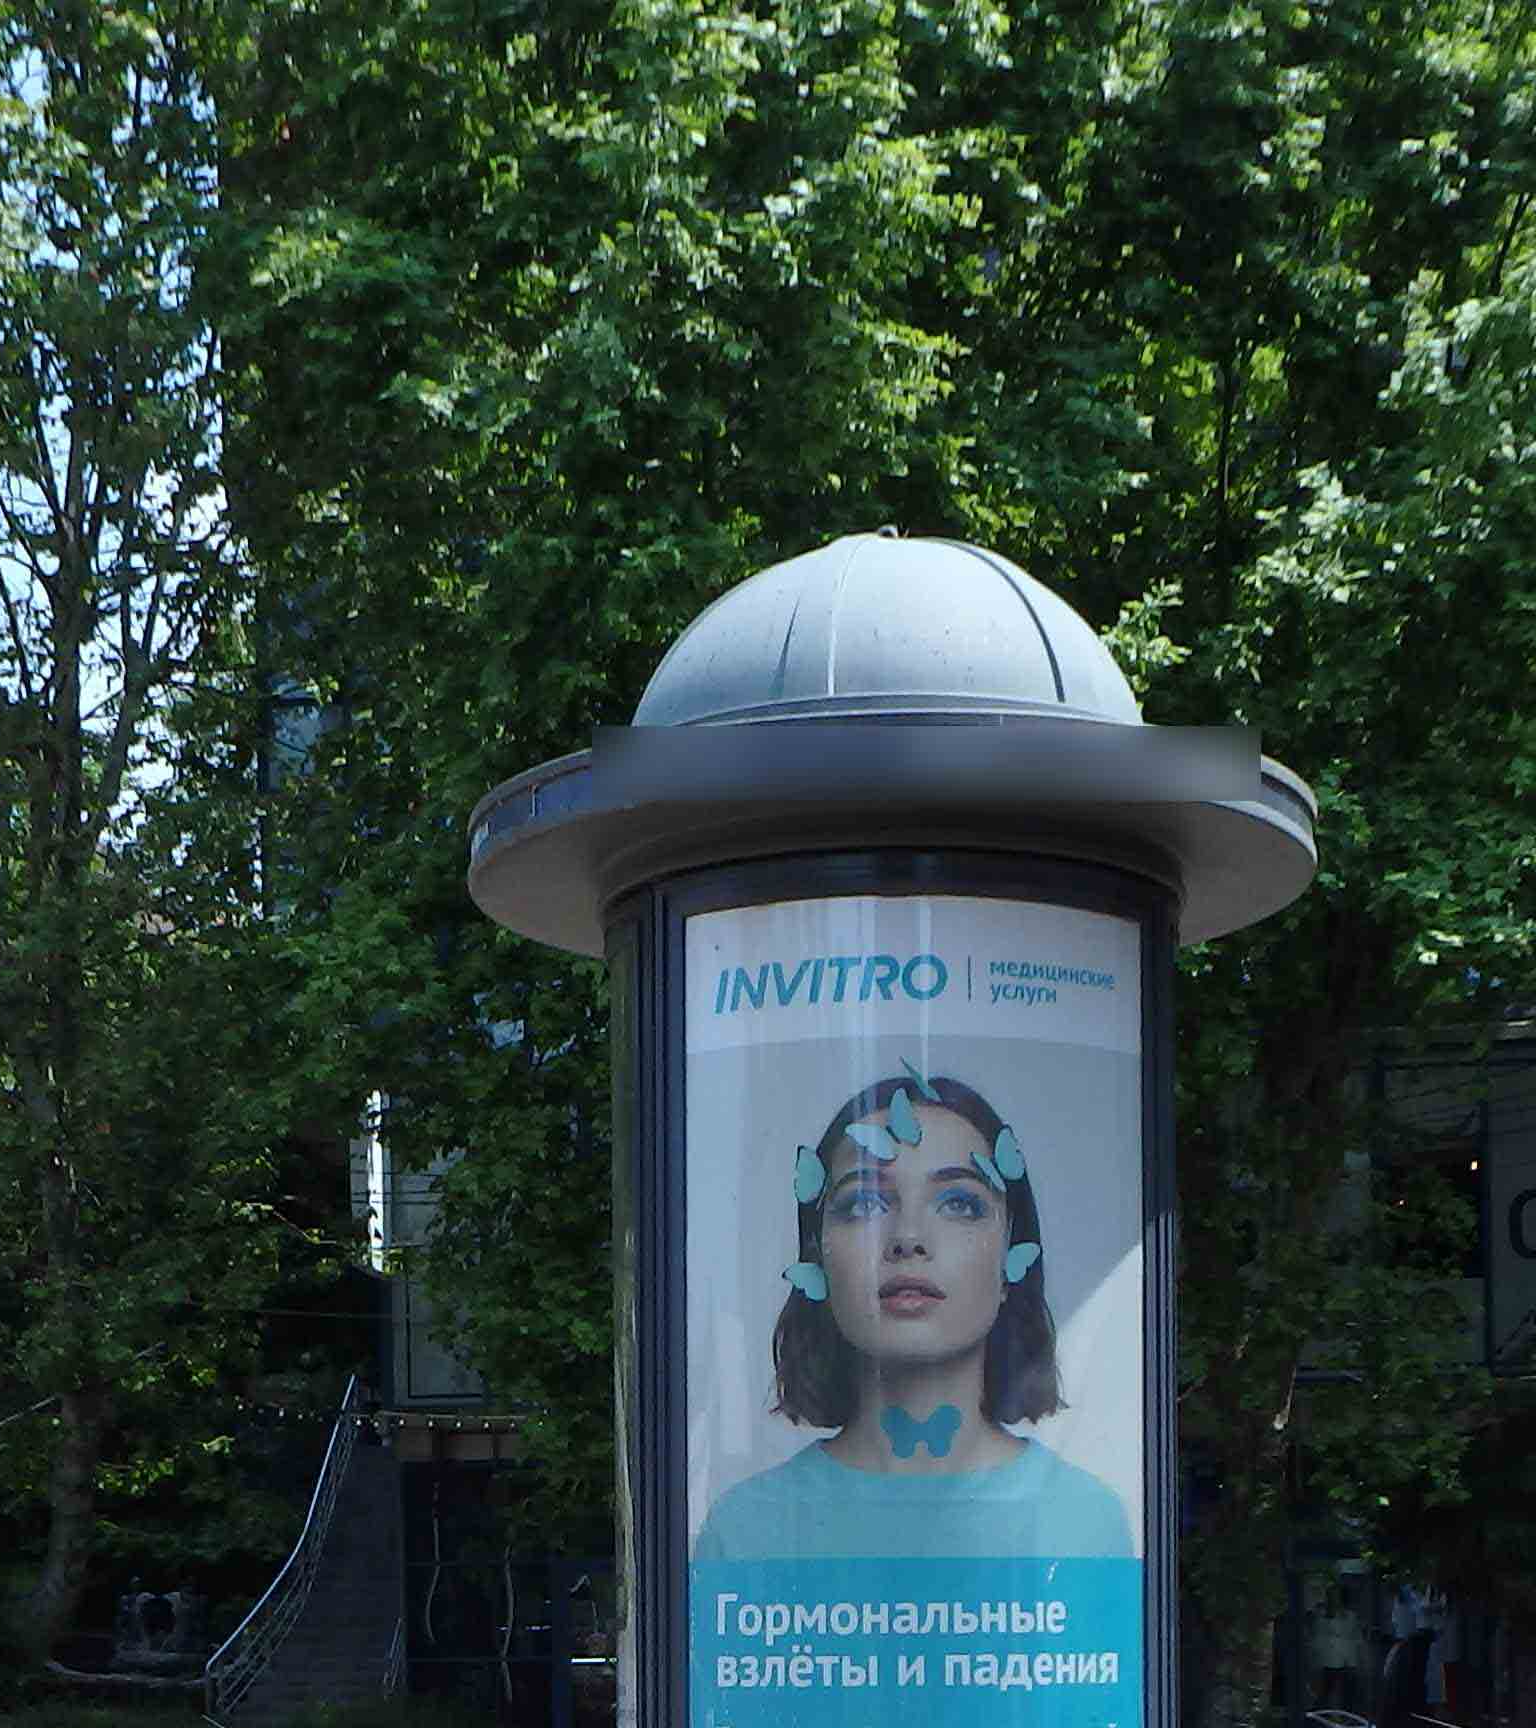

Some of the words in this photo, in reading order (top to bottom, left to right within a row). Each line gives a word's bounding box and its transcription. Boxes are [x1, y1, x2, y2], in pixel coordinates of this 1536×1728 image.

[714, 954, 948, 1014] INVITRO
[989, 960, 1115, 991] медицинские
[990, 984, 1058, 1008] услуги
[714, 1593, 1068, 1646] Гормональные
[716, 1646, 879, 1688] взлёты
[898, 1657, 925, 1687] и
[945, 1652, 1119, 1691] падения
